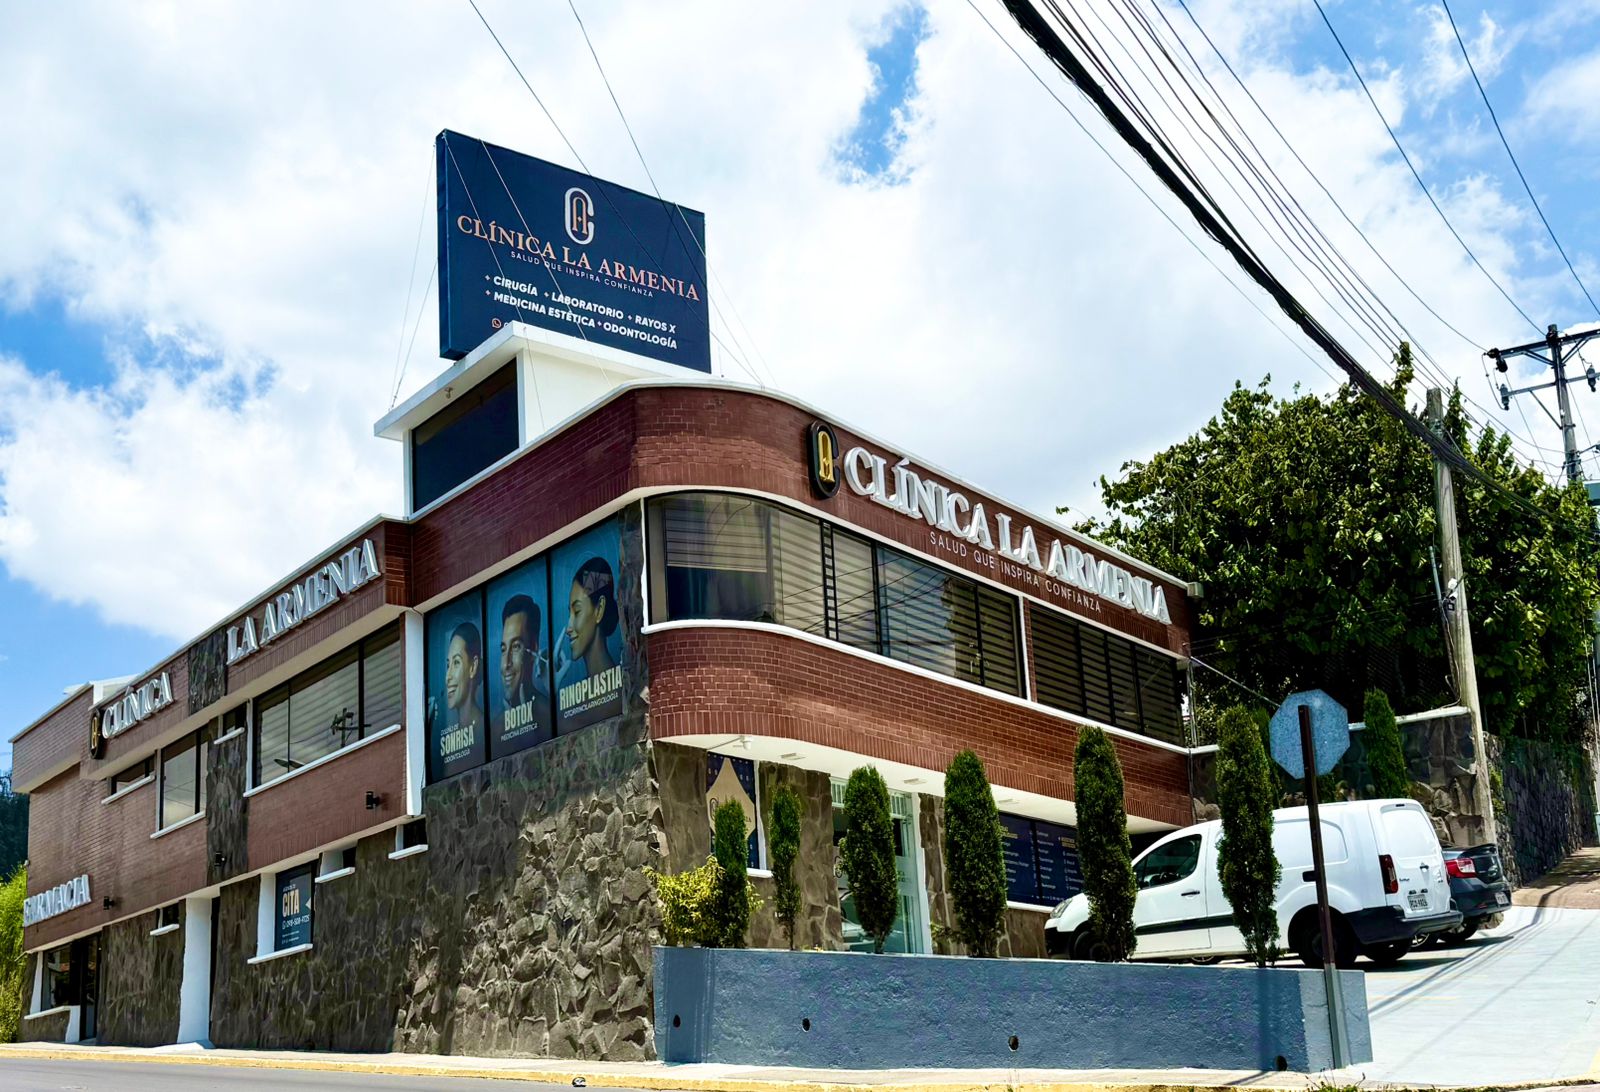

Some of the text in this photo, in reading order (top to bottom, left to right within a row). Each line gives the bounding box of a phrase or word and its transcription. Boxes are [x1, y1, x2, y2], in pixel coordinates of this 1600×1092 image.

[456, 215, 701, 302] CLÍNICA LA ARMENIA
[510, 251, 654, 298] SALUD QUE INSPIRA CONFIANZA
[493, 276, 676, 334] CIRUGÍA LABORATORIO RAYOS X
[494, 291, 678, 350] MEDICINA ESTÉTICA ODONTOLOGÍA
[843, 446, 1173, 625] CLÍNICA LA ARMENIA
[930, 531, 1102, 614] SALUD QUE INSPIRA CONFIANZA
[102, 538, 381, 740] CLÍNICA LA ARMENIA
[504, 700, 533, 731] BOTOX
[559, 664, 622, 711] RINOPLASTIA
[440, 724, 474, 757] SONRISA
[282, 888, 299, 918] CITA
